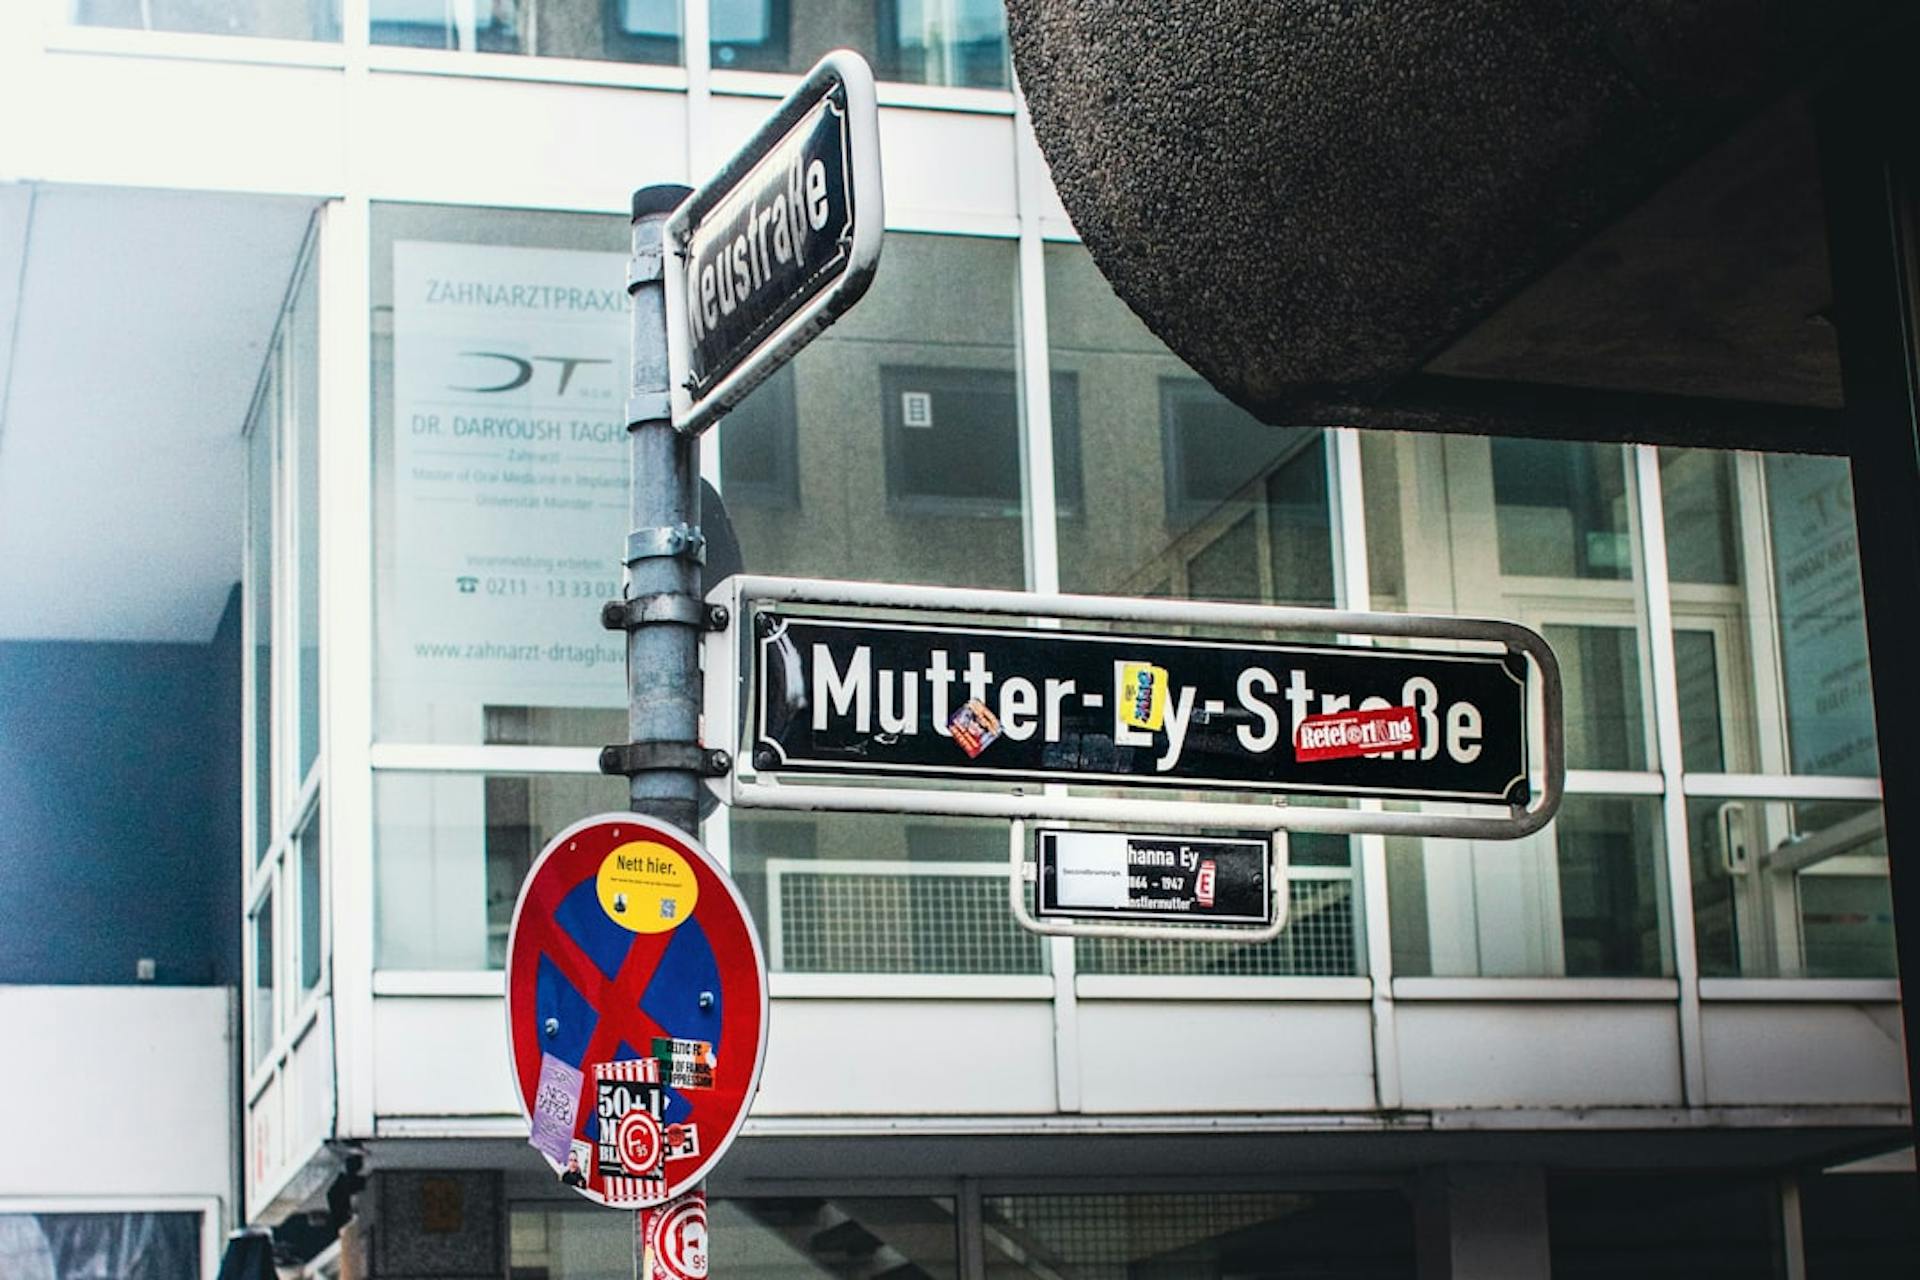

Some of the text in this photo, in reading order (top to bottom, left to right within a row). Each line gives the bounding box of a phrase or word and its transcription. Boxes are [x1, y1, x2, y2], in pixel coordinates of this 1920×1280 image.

[453, 416, 560, 440] DARYOUSH
[569, 420, 630, 443] TAGHA
[486, 577, 527, 595] 0211
[415, 640, 625, 667] www.zahnarzt-drtaghav
[616, 855, 677, 875] Nett hier.
[1128, 843, 1199, 872] hanna Ey
[1161, 876, 1184, 891] 1947
[598, 1085, 662, 1120] 50+1
